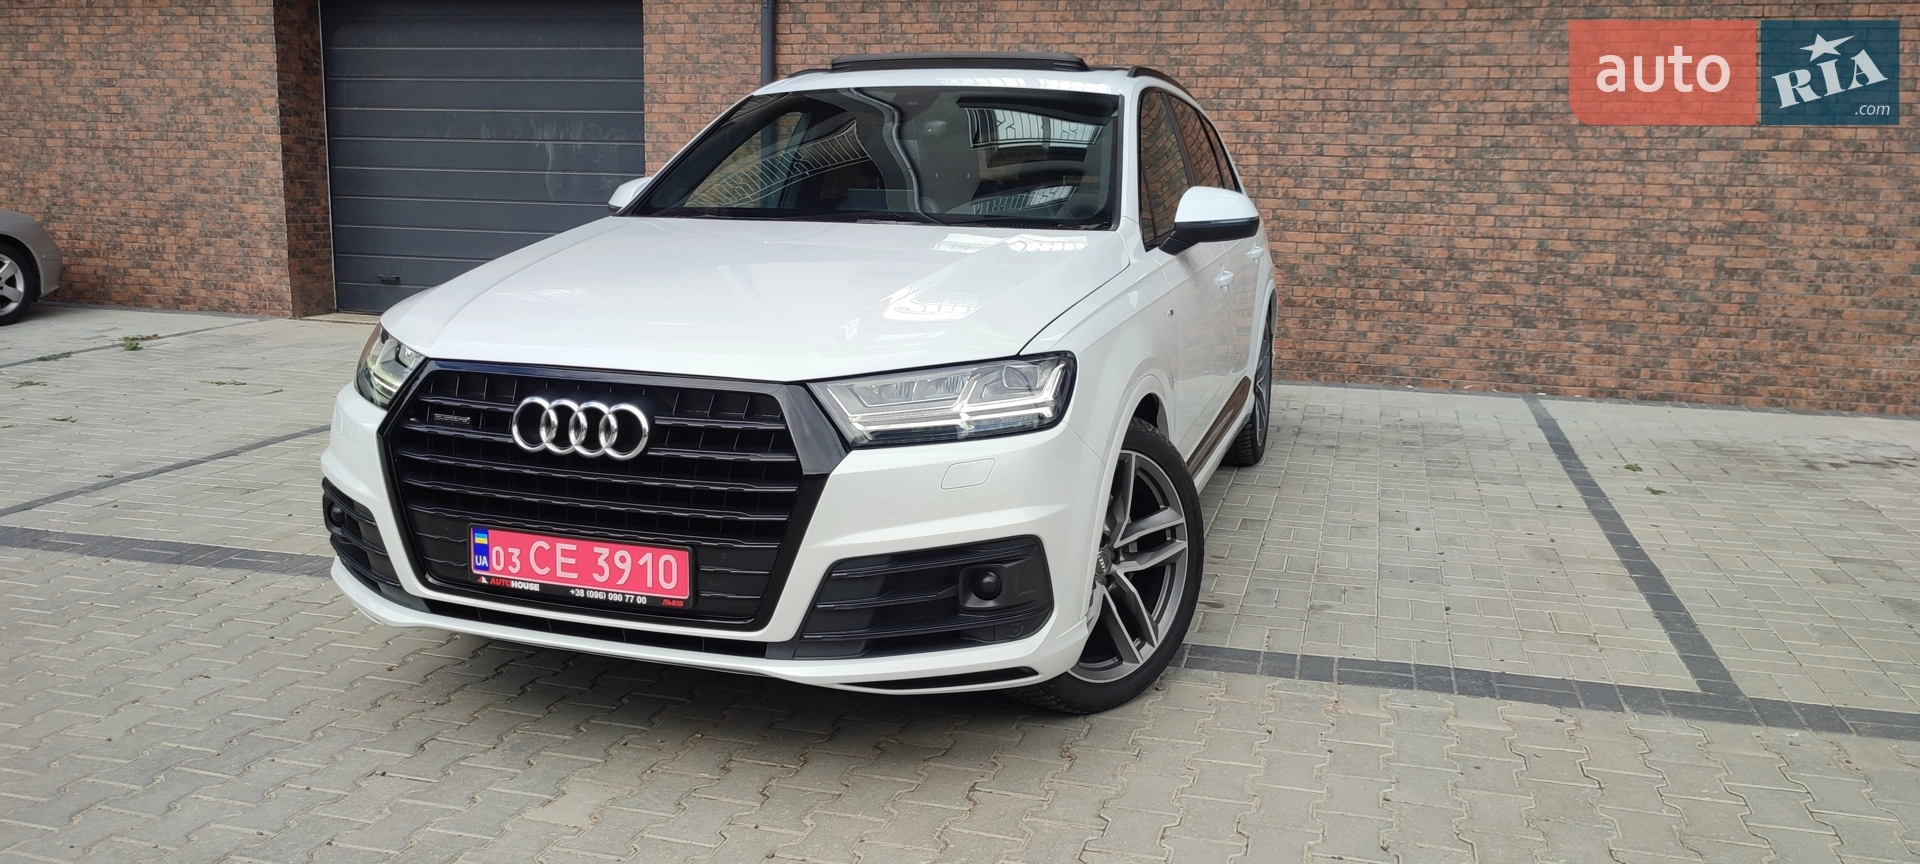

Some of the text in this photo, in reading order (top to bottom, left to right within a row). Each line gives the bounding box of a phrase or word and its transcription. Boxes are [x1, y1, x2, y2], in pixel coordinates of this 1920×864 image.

[475, 555, 489, 567] UA
[491, 540, 678, 590] 03 CE 3910
[490, 578, 540, 591] AUTOHOUSE
[570, 588, 647, 604] +38 (096) 090 77 00
